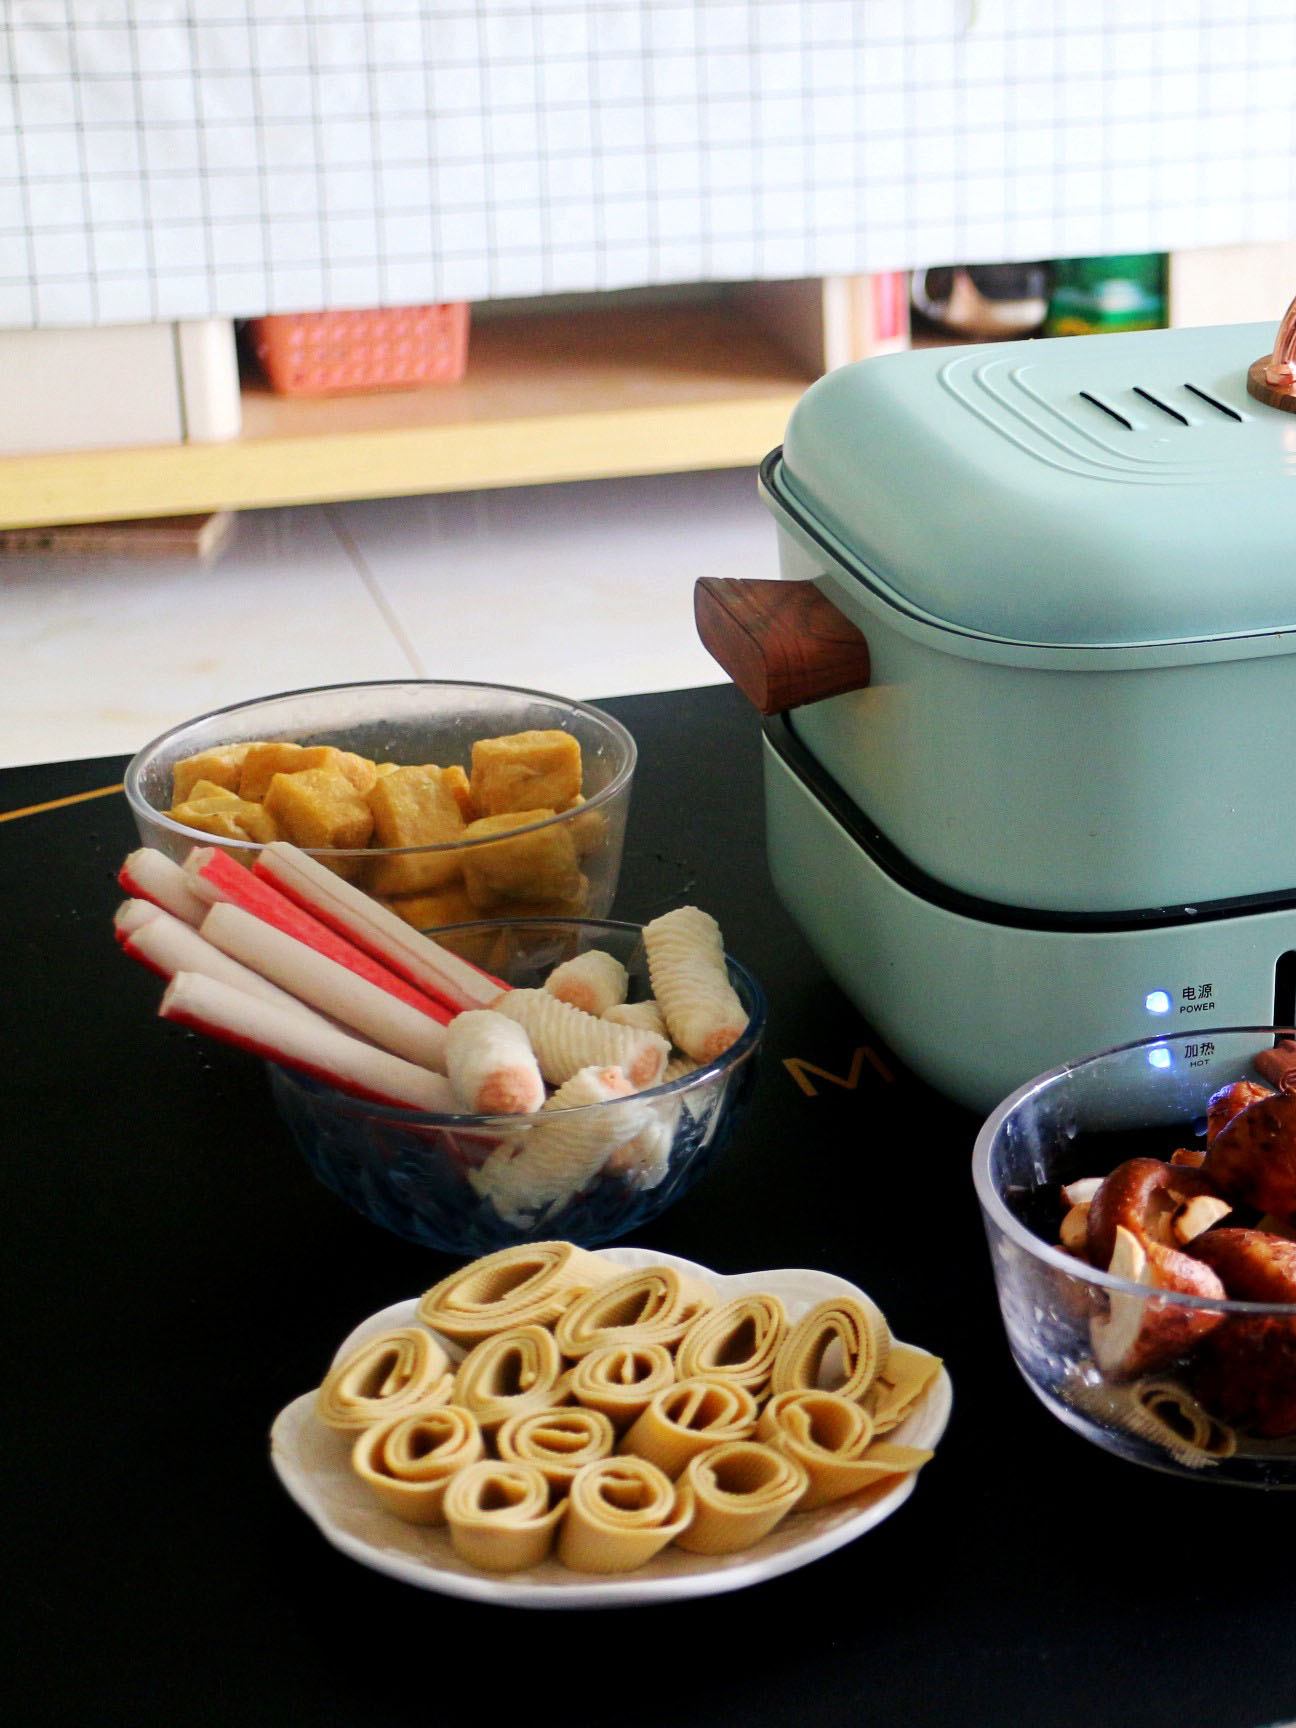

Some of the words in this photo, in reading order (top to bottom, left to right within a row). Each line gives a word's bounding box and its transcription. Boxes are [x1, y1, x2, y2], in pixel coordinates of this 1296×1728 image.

[1182, 983, 1213, 1001] 电源
[1179, 1002, 1215, 1014] POWER
[1184, 1042, 1215, 1059] 加热
[782, 1047, 896, 1097] M
[1190, 1059, 1210, 1068] HOT
